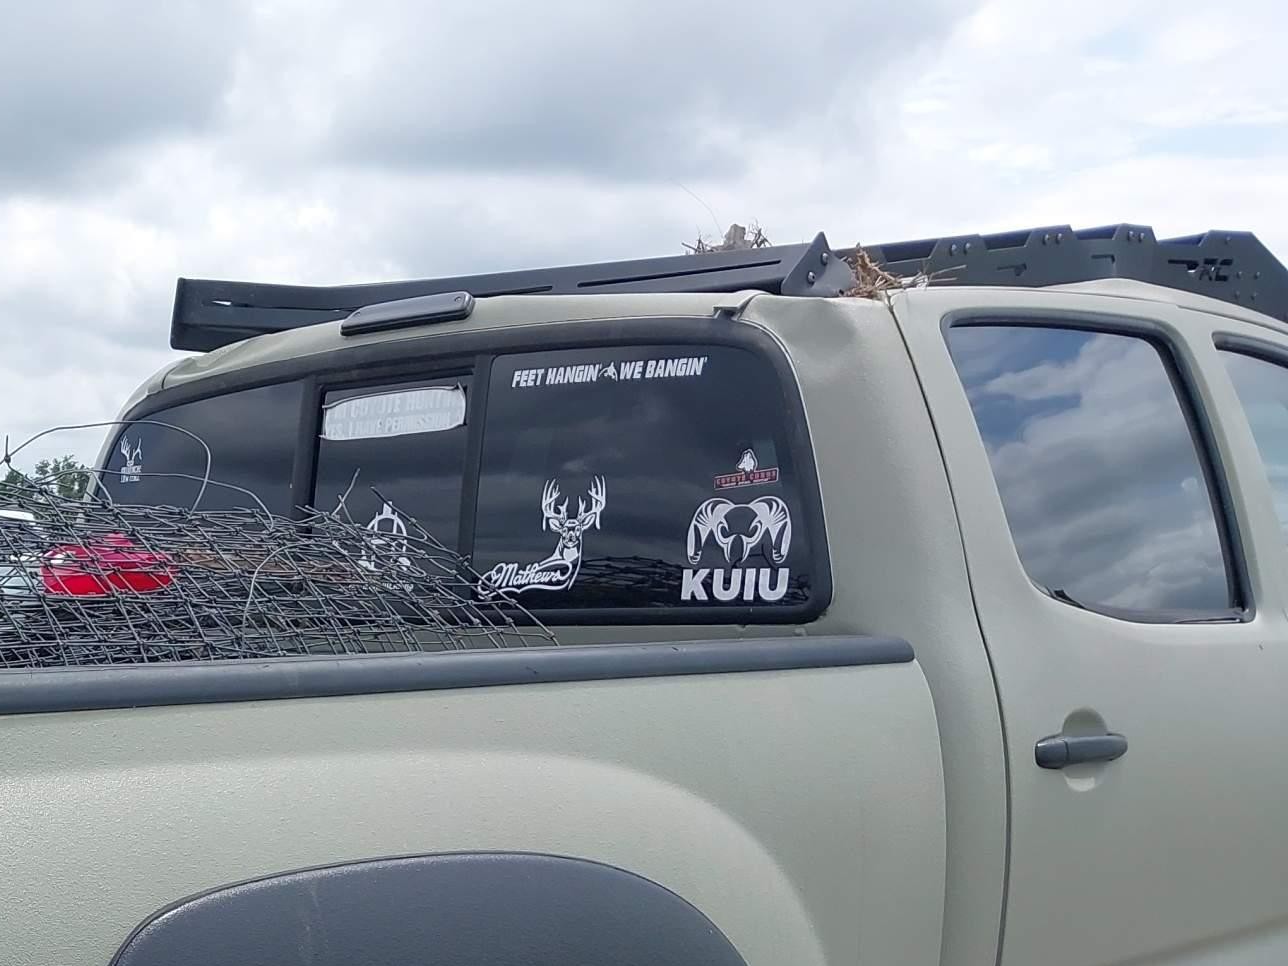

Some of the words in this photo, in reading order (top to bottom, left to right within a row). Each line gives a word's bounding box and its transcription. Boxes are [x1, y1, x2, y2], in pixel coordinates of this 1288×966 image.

[512, 368, 545, 388] FEET
[546, 363, 602, 385] HANGIN'
[620, 360, 643, 380] WE
[645, 356, 708, 378] BANGIN'
[491, 562, 563, 586] Mathews
[681, 567, 789, 600] KUIU
